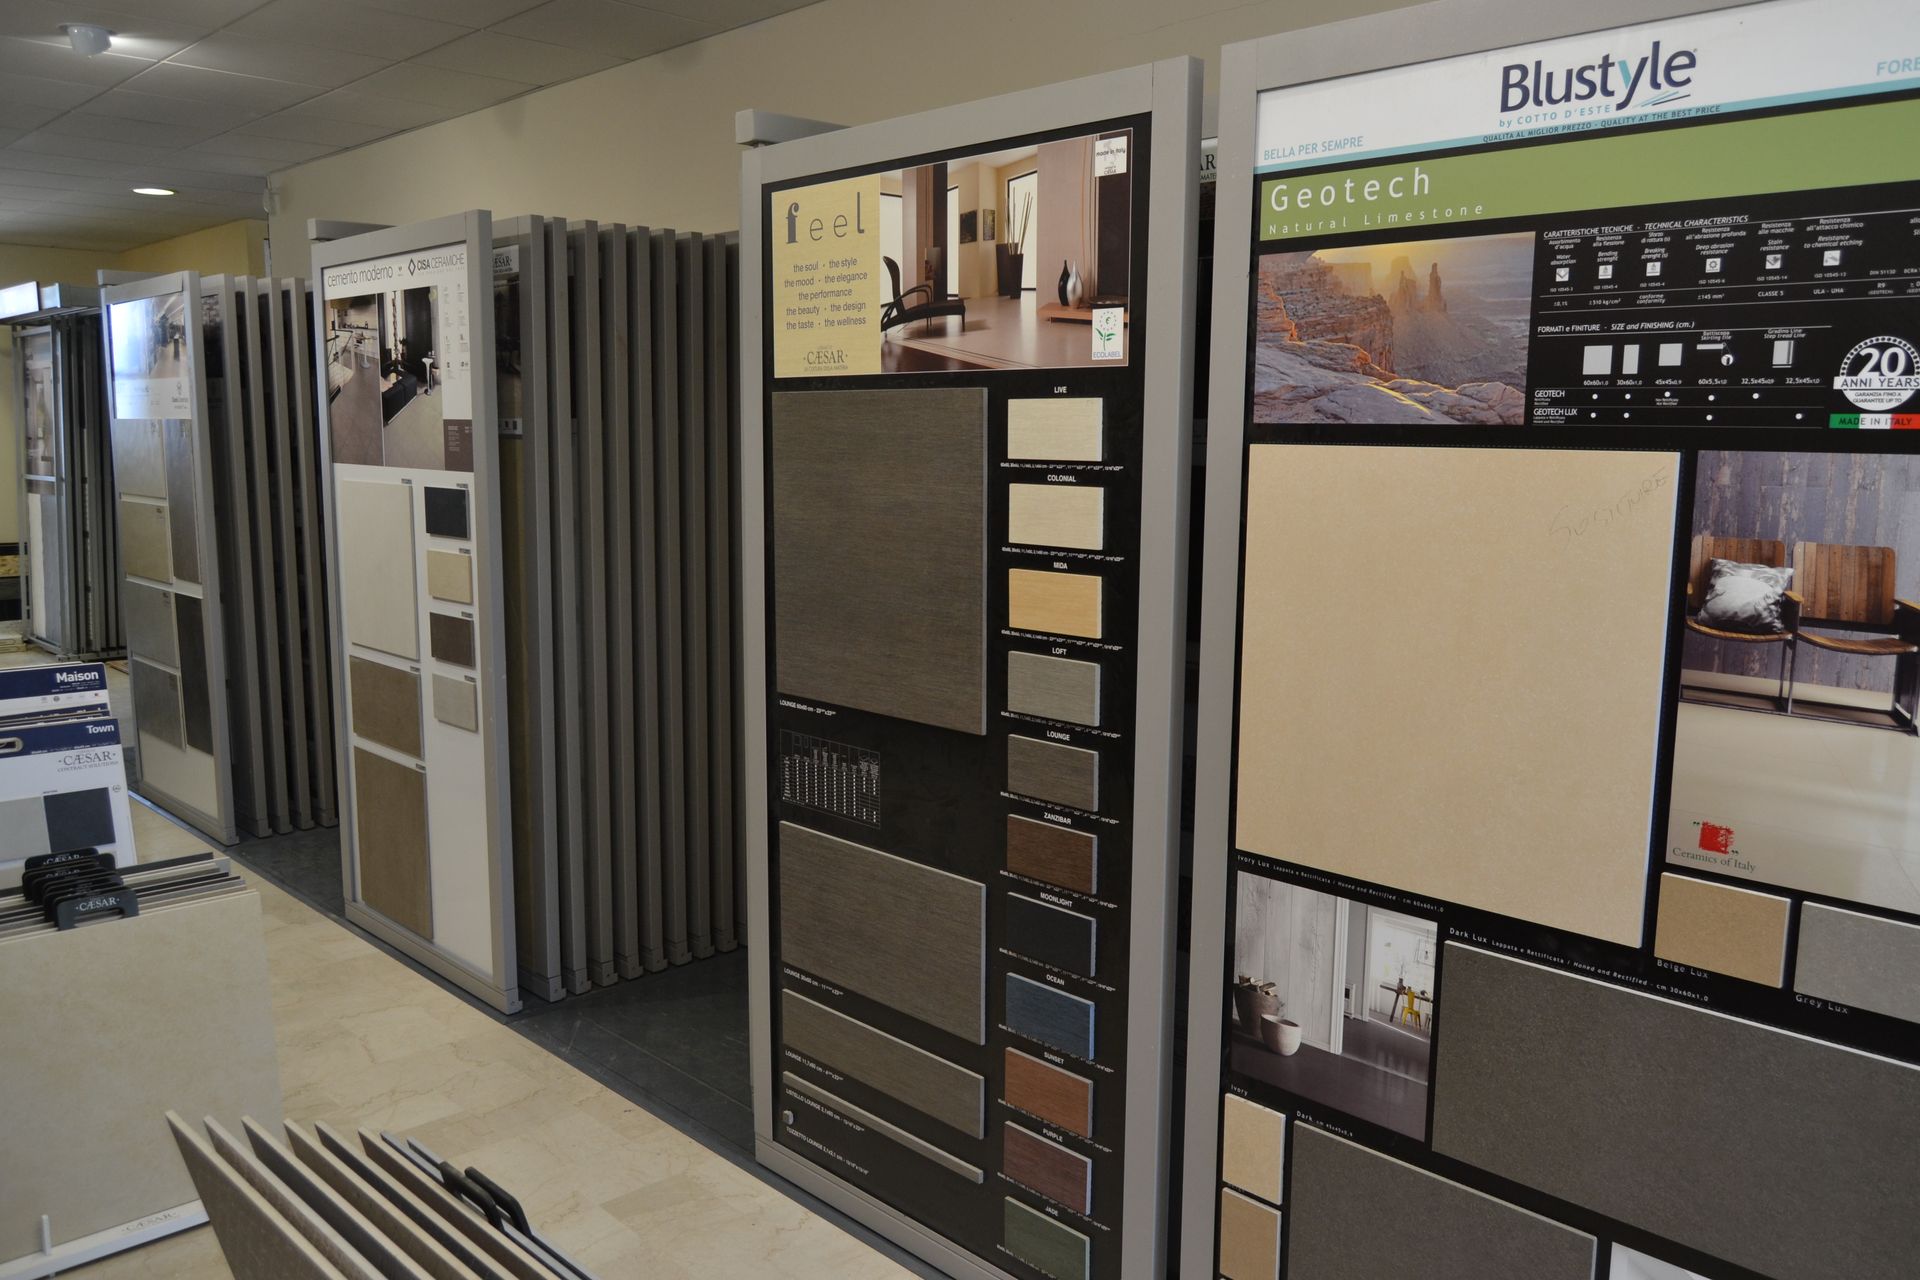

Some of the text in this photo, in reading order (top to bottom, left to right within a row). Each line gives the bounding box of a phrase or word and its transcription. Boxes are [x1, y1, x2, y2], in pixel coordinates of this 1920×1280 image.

[1500, 40, 1697, 113] Blustyle
[1483, 104, 1721, 143] QUALITA AL MIGLIOR PREZZO QUALITY AT THE BEST PRICE
[1499, 104, 1611, 129] by COTTO D'ESTE
[1264, 136, 1364, 160] BELLA PER SEMPRE
[1271, 167, 1430, 212] Geotech
[785, 192, 865, 244] feel
[1269, 203, 1483, 235] Natural Limestone
[1543, 215, 1749, 239] CARATTERISTICHE TECNICHE TECHNICAL CHARACTERISTICS
[1840, 222, 1864, 230] chimico
[1760, 244, 1790, 252] resistance
[1839, 239, 1863, 247] etching
[793, 257, 857, 273] the soul the style
[327, 264, 394, 288] cemento moderno
[784, 271, 868, 288] the mood the elegance
[798, 288, 852, 302] the performance
[786, 301, 866, 316] the beauty the design
[786, 316, 866, 330] the taste the wellness
[1537, 325, 1564, 333] FORMATI
[1571, 324, 1600, 332] FINITURE
[1610, 323, 1625, 331] SIZE
[1626, 322, 1639, 330] and
[1640, 321, 1674, 330] FINISHING
[1856, 346, 1906, 378] 20
[1841, 377, 1920, 388] ANNI YEARS
[1054, 386, 1068, 394] LIVE
[1534, 390, 1565, 398] GEOTECH
[1533, 407, 1577, 416] GEOTECH LUX
[1838, 417, 1866, 425] MADE
[1884, 417, 1913, 425] ITALY
[1047, 474, 1077, 483] COLONIAL
[1052, 647, 1068, 656] LOFT
[55, 671, 99, 684] Maison
[85, 724, 115, 734] Town
[1046, 730, 1071, 741] LOUNGE
[1043, 811, 1072, 825] ZANZIBAR
[1672, 847, 1757, 874] Ceramics of Italy
[1237, 854, 1256, 865] Ivory
[1257, 858, 1270, 869] Lux
[1356, 885, 1368, 894] and
[1040, 891, 1073, 908] MOONLIGHT
[1449, 927, 1469, 939] Dark
[1472, 933, 1488, 944] Lux
[1491, 940, 1518, 953] Lappata
[1526, 948, 1565, 964] Rettificata
[1573, 960, 1595, 972] Honed
[1597, 967, 1611, 977] and
[1612, 971, 1648, 987] Rectified
[1656, 959, 1709, 979] Beige Lux
[1046, 973, 1065, 986] OCEAN
[1795, 994, 1848, 1015] Grey Lux
[1043, 1051, 1065, 1065] SUNSET
[1230, 1083, 1249, 1098] Ivory
[1296, 1109, 1314, 1123] Dark
[1042, 1127, 1064, 1143] PURPLE
[1045, 1205, 1059, 1217] JADE
